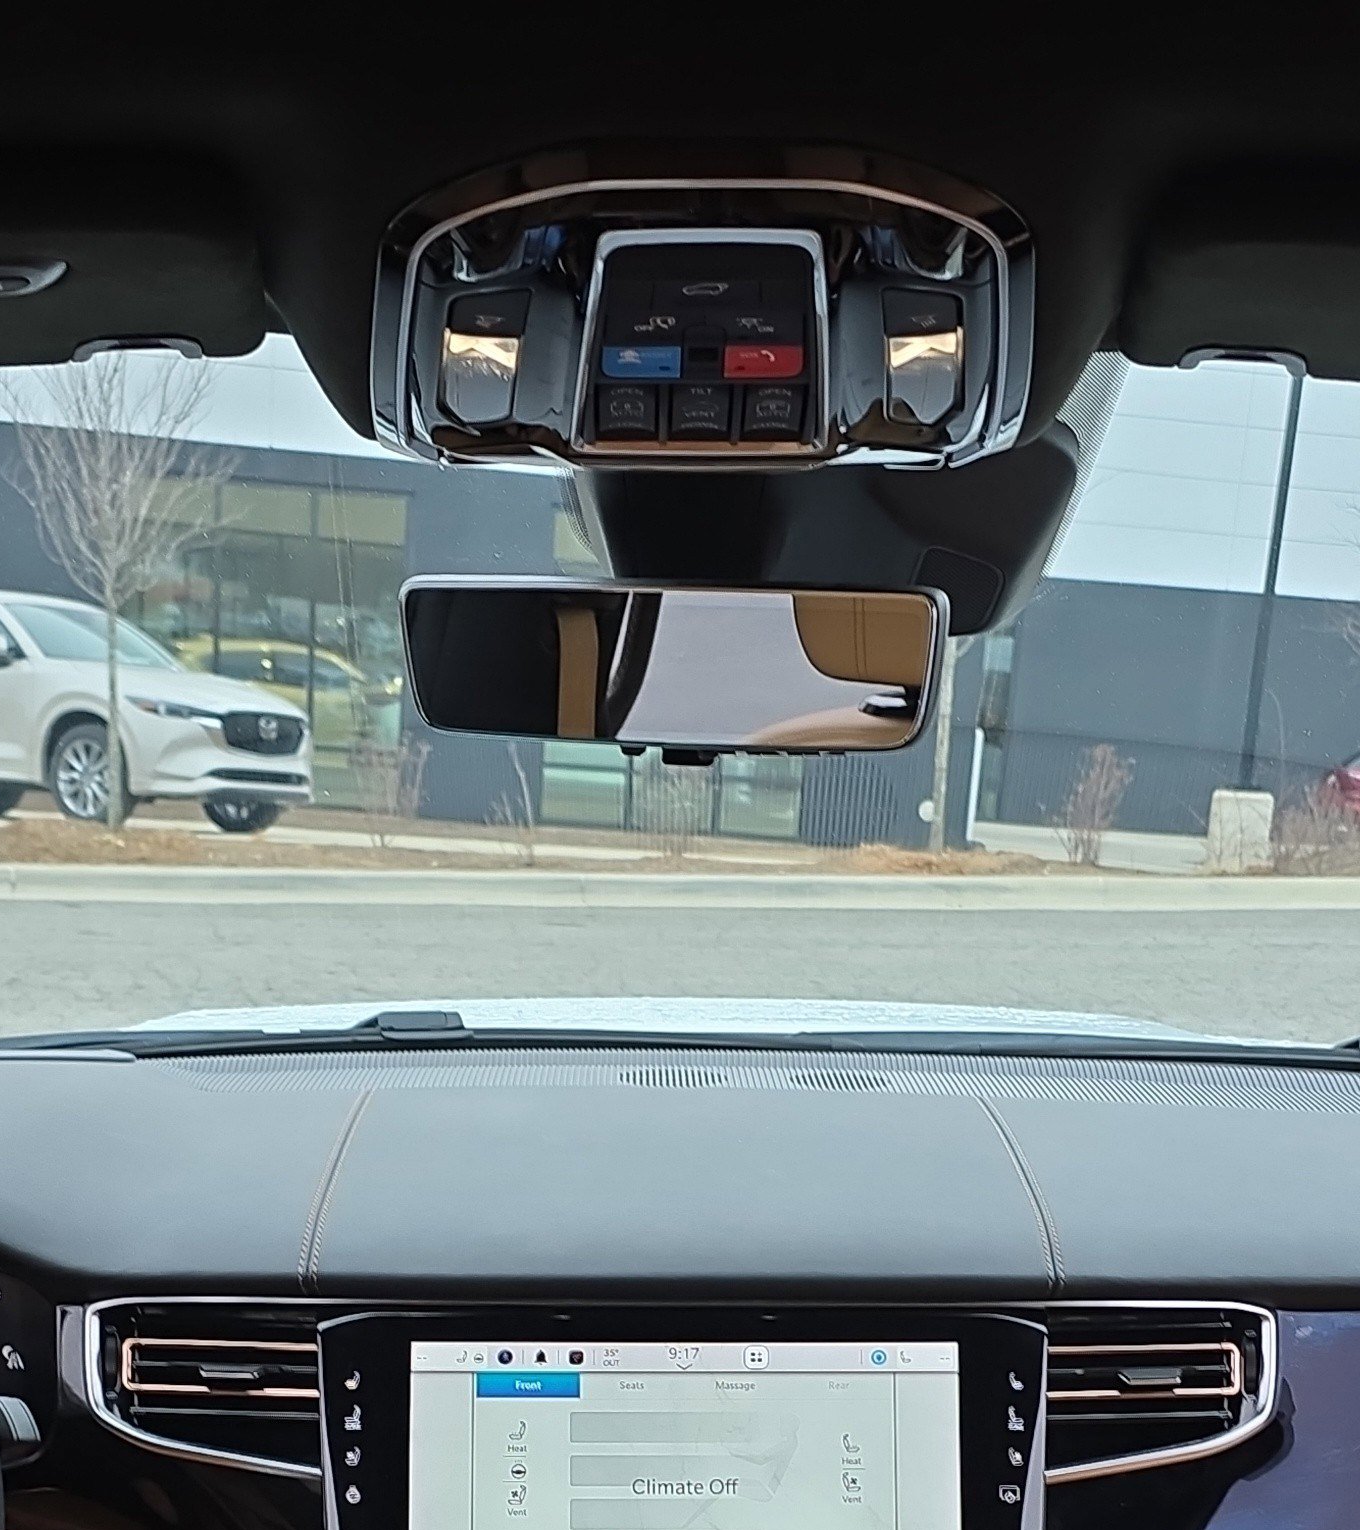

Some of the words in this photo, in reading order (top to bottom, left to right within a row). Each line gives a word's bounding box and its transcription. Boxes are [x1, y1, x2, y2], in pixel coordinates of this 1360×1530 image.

[668, 1347, 700, 1361] 9:17
[602, 1358, 620, 1367] OUT
[514, 1379, 543, 1391] Front
[619, 1380, 645, 1391] Seats
[715, 1380, 756, 1392] Massage
[828, 1380, 850, 1391] Rear
[507, 1444, 528, 1453] Heat
[842, 1457, 862, 1466] Heat
[631, 1478, 704, 1496] Climate
[709, 1477, 739, 1496] Off
[842, 1495, 862, 1504] Vent
[507, 1508, 528, 1517] Vent
